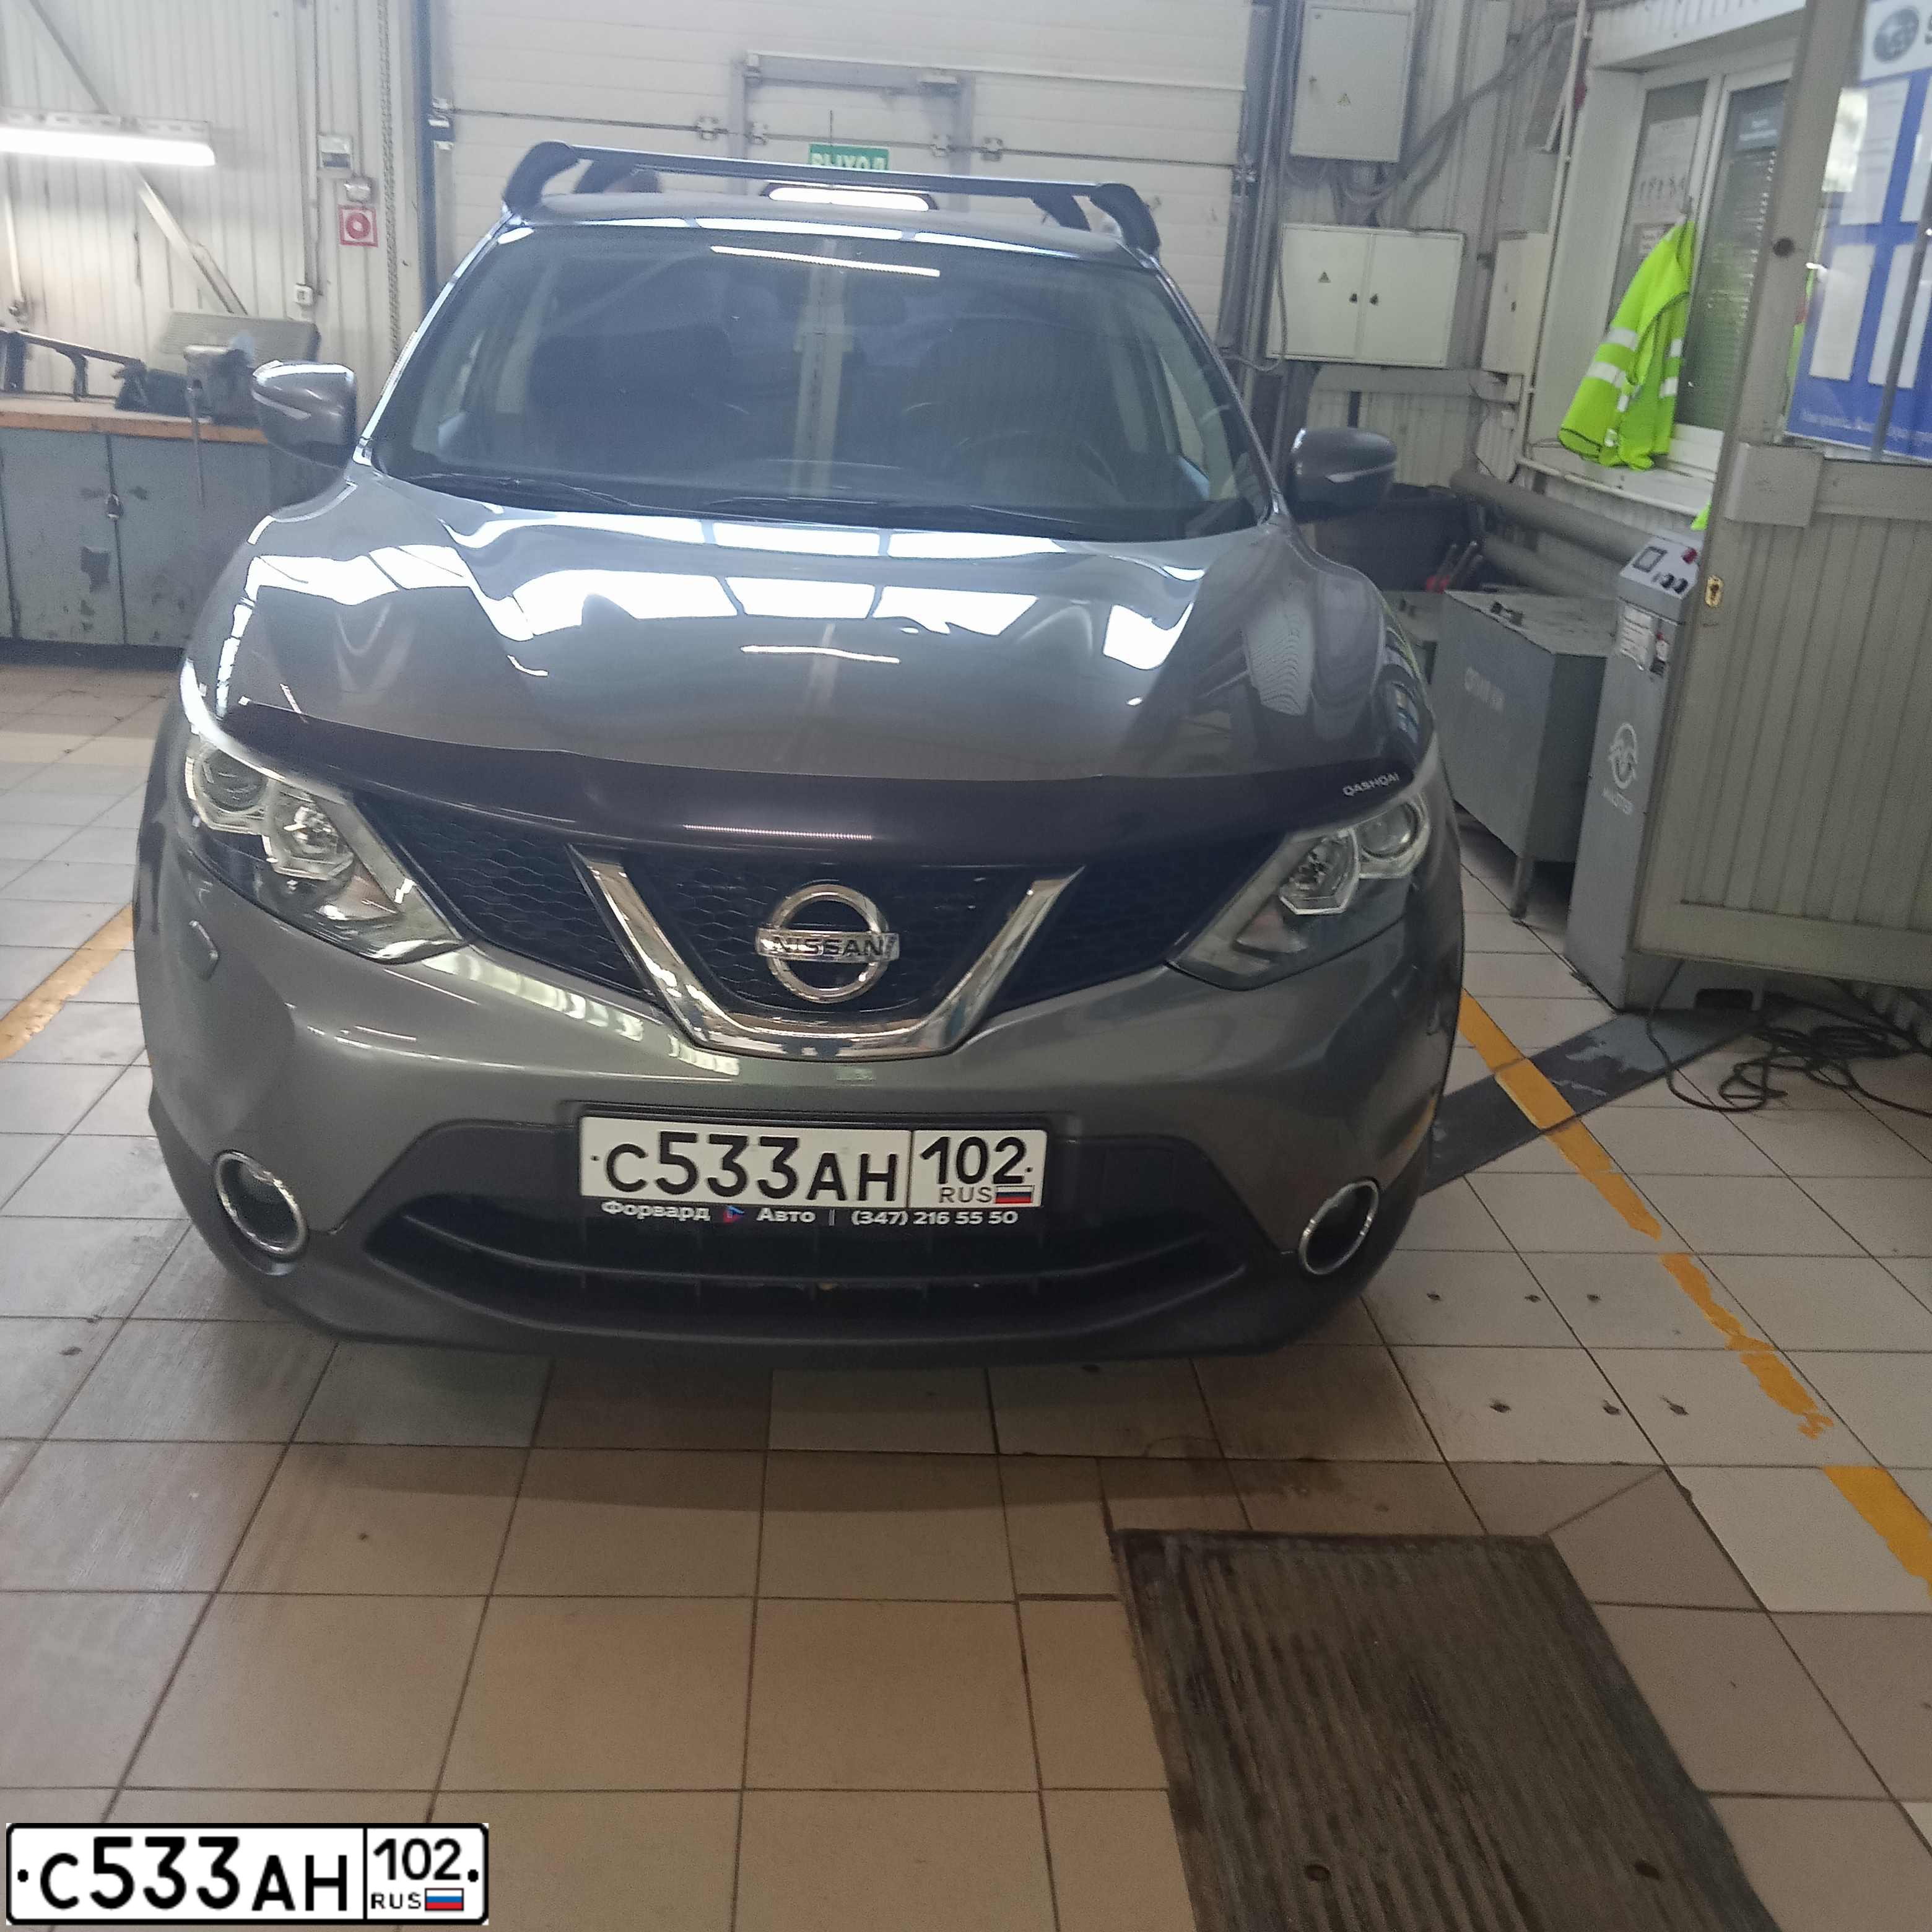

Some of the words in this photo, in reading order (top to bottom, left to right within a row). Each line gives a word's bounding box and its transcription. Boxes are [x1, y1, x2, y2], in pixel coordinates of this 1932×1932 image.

[773, 937, 884, 957] NISSAN
[921, 1136, 1025, 1184] 102
[939, 1186, 992, 1203] RUS
[601, 1201, 711, 1222] Форвард
[756, 1208, 816, 1222] Авто
[851, 1211, 908, 1225] (347)
[913, 1211, 950, 1225] 216
[954, 1211, 983, 1225] 55
[988, 1211, 1019, 1225] 50
